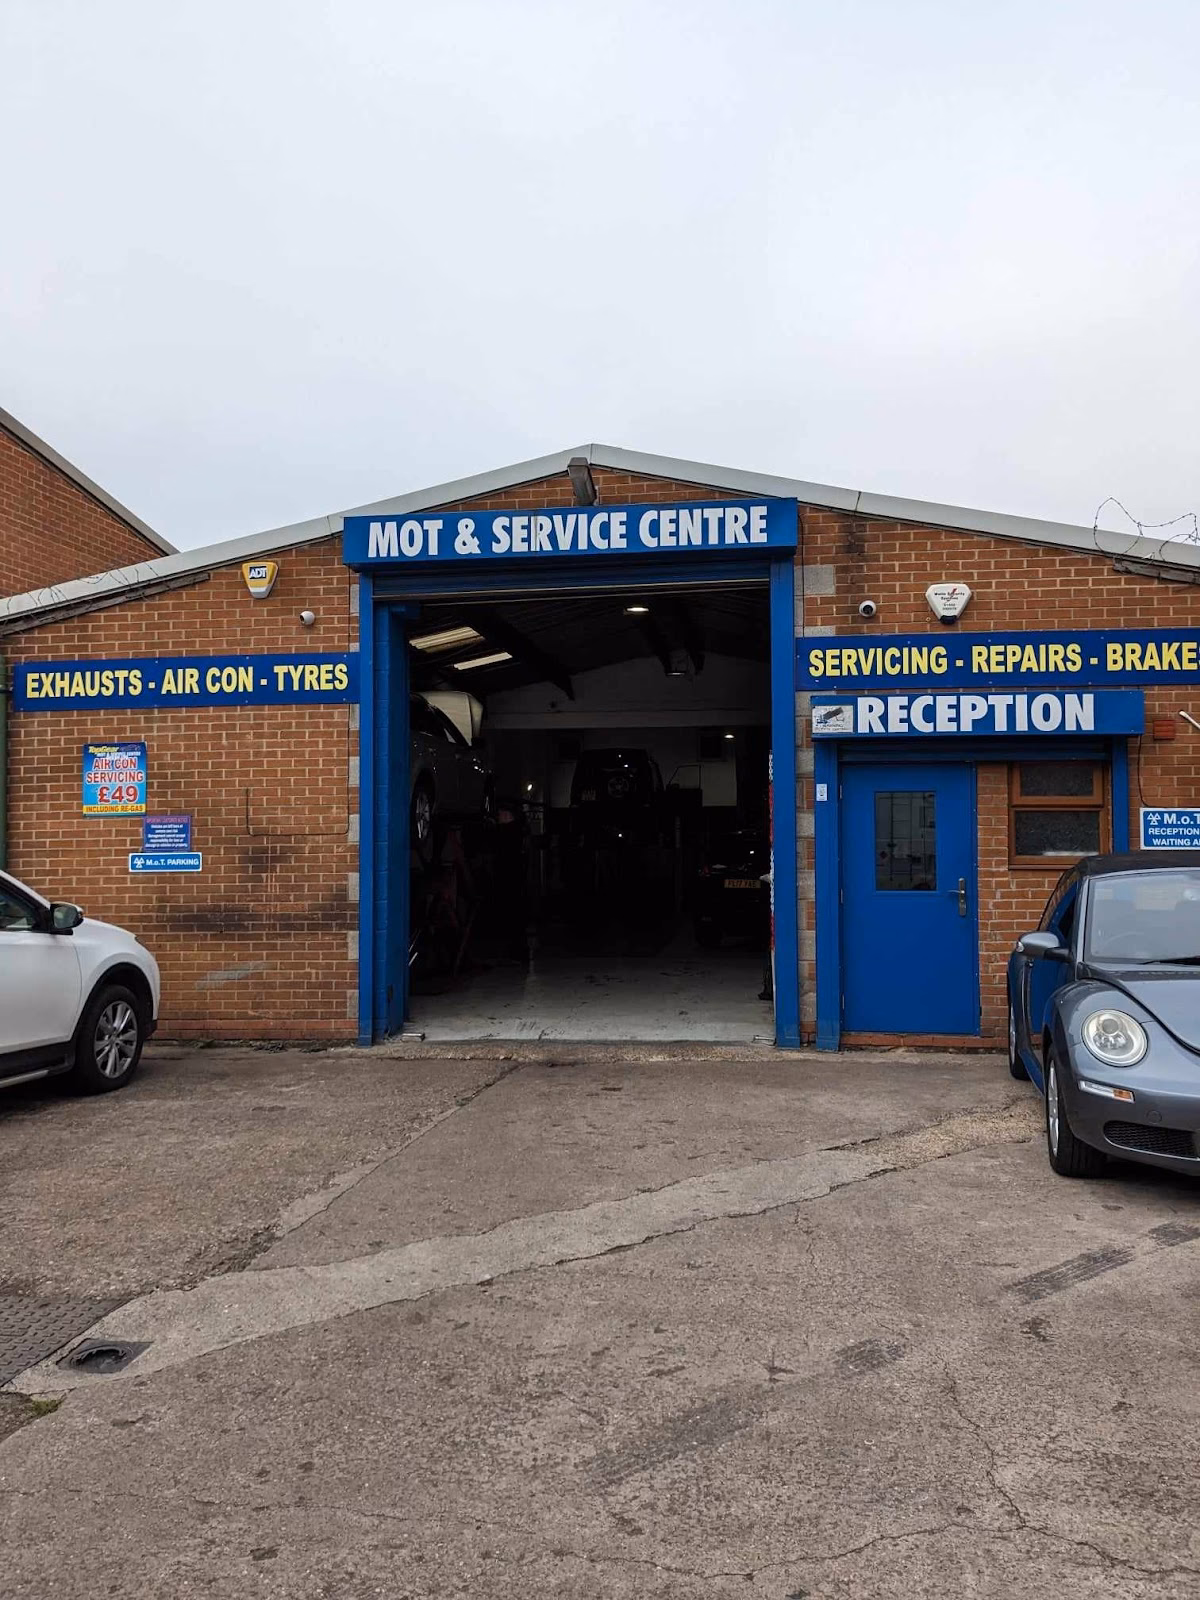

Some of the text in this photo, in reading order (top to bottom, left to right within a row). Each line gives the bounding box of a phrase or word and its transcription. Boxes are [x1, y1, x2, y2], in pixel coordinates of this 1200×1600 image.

[368, 506, 768, 558] MOT & SERVICE CENTRE
[249, 567, 267, 578] ADT
[809, 646, 948, 677] SERVICING
[972, 644, 1082, 673] REPAIRS
[1106, 641, 1200, 671] BRAKE
[26, 669, 143, 699] EXHAUSTS
[161, 668, 200, 695] AIR
[206, 666, 254, 694] CON
[273, 664, 349, 692] TYRES
[856, 694, 1095, 734] RECEPTION
[93, 757, 138, 771] AIR CON
[86, 771, 143, 784] SERVICING
[98, 785, 138, 803] £49
[86, 804, 143, 813] INCLUDING RE-GAS
[1148, 827, 1200, 836] RECEPTION
[1153, 838, 1191, 846] WAITING
[167, 858, 199, 866] PARKING
